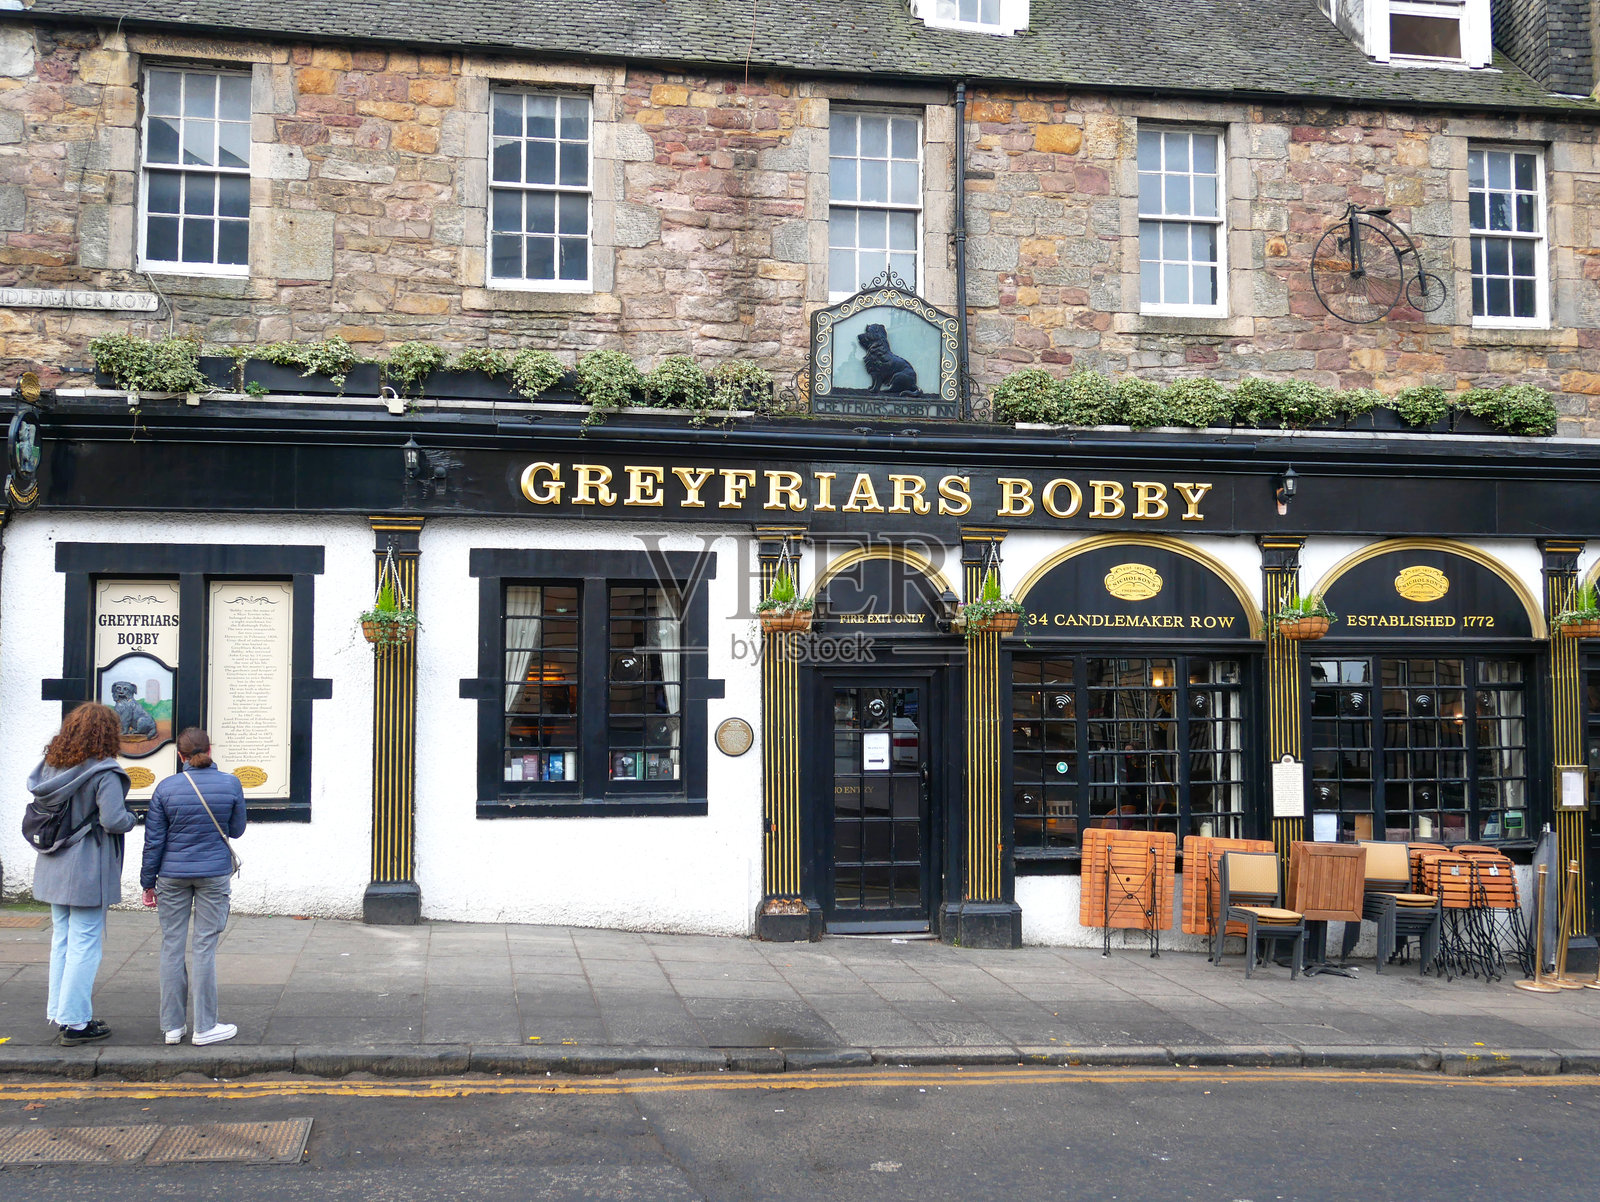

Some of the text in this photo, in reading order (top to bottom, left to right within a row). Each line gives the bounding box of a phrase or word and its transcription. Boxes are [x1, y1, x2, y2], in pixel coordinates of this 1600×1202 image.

[110, 294, 153, 308] ROW
[815, 400, 956, 418] GREYFRIARS BOBBY INN
[520, 461, 1213, 521] GREYFRIARS BOBBY
[98, 614, 179, 627] GREYFRIARS
[839, 613, 926, 624] FIRE EXIT ONLY
[1027, 613, 1236, 629] 34 CANDLEMAKER ROW
[1346, 614, 1495, 628] ESTABLISHED 1772
[117, 632, 160, 645] BOBBY
